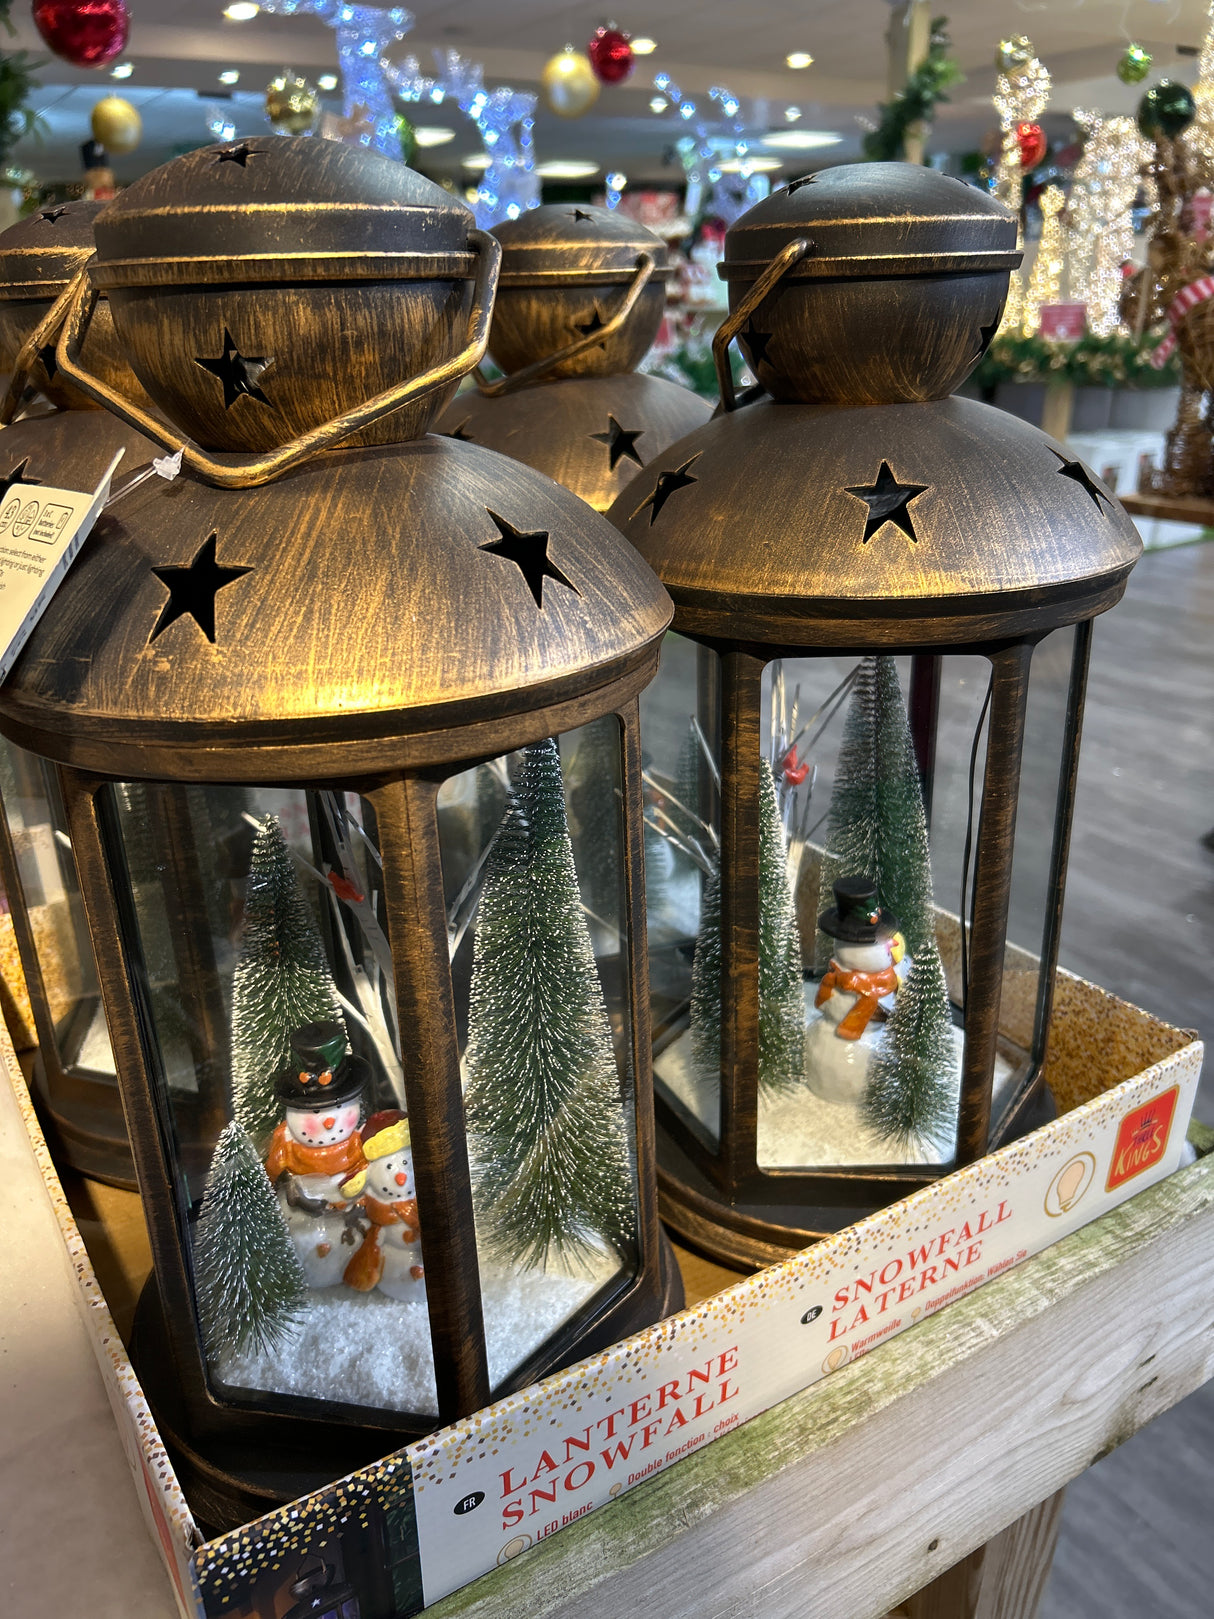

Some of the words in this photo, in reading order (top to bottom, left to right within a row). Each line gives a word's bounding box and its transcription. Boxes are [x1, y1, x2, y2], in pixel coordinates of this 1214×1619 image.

[827, 1240, 983, 1343] LATERNE
[832, 1200, 1013, 1313] SNOWFALL
[987, 1257, 1012, 1277] Wählen
[1010, 1249, 1028, 1264] Sie
[807, 1308, 818, 1321] DE
[499, 1346, 739, 1499] LANTERNE
[502, 1378, 740, 1531] SNOWFALL
[627, 1457, 663, 1485] Double
[665, 1432, 705, 1461] fonction
[713, 1412, 740, 1433] choix
[462, 1496, 476, 1511] FR
[537, 1519, 558, 1541] LED
[562, 1501, 593, 1525] blanc
